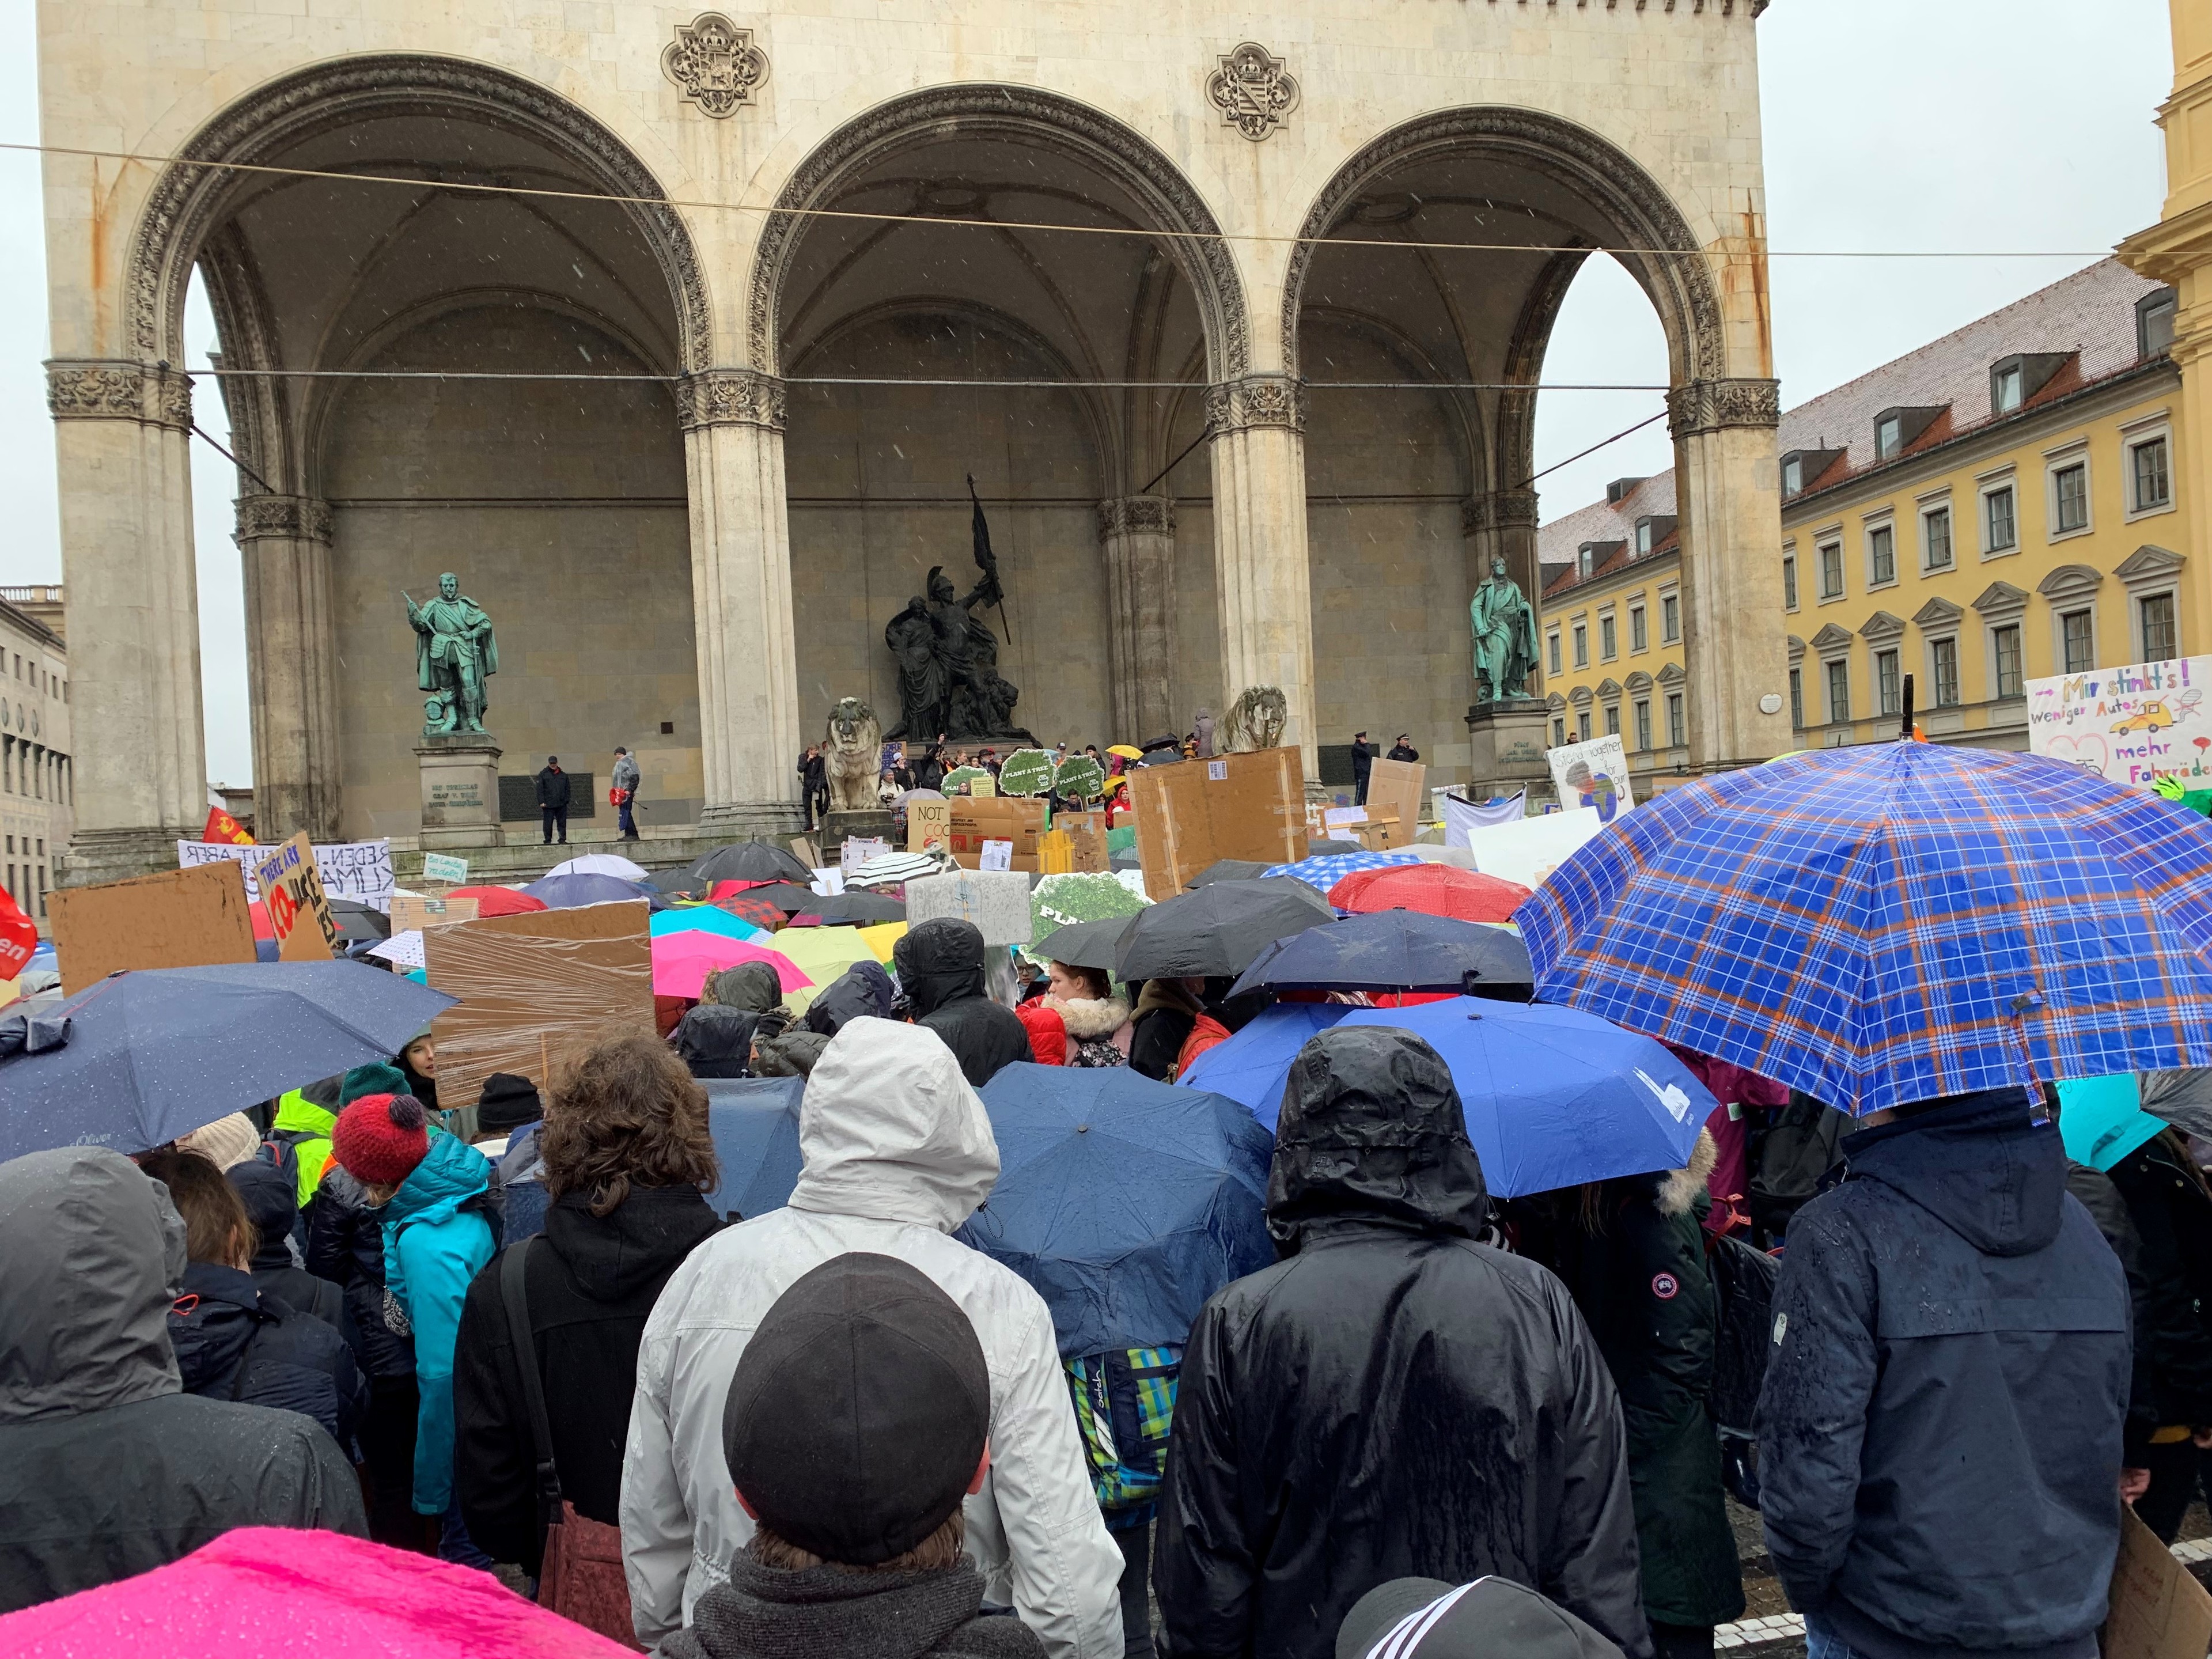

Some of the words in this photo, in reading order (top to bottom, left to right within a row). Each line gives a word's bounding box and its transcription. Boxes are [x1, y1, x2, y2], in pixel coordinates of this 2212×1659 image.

[2063, 675, 2100, 702] Mir
[2107, 659, 2190, 696] stinkt's!
[2031, 704, 2086, 725] weniger
[2096, 698, 2139, 717] Autos
[2116, 736, 2171, 759] mehr
[1005, 770, 1025, 778] PLANT
[1059, 775, 1079, 785] PLANT
[1081, 770, 1097, 779] TREE
[1604, 760, 1616, 775] for
[2130, 757, 2212, 783] Fahrräde
[1613, 774, 1626, 785] our
[918, 806, 944, 820] NOT
[260, 857, 283, 888] THERE
[283, 844, 300, 870] ARE
[1039, 904, 1085, 926] PLA
[1092, 1369, 1104, 1408] satch
